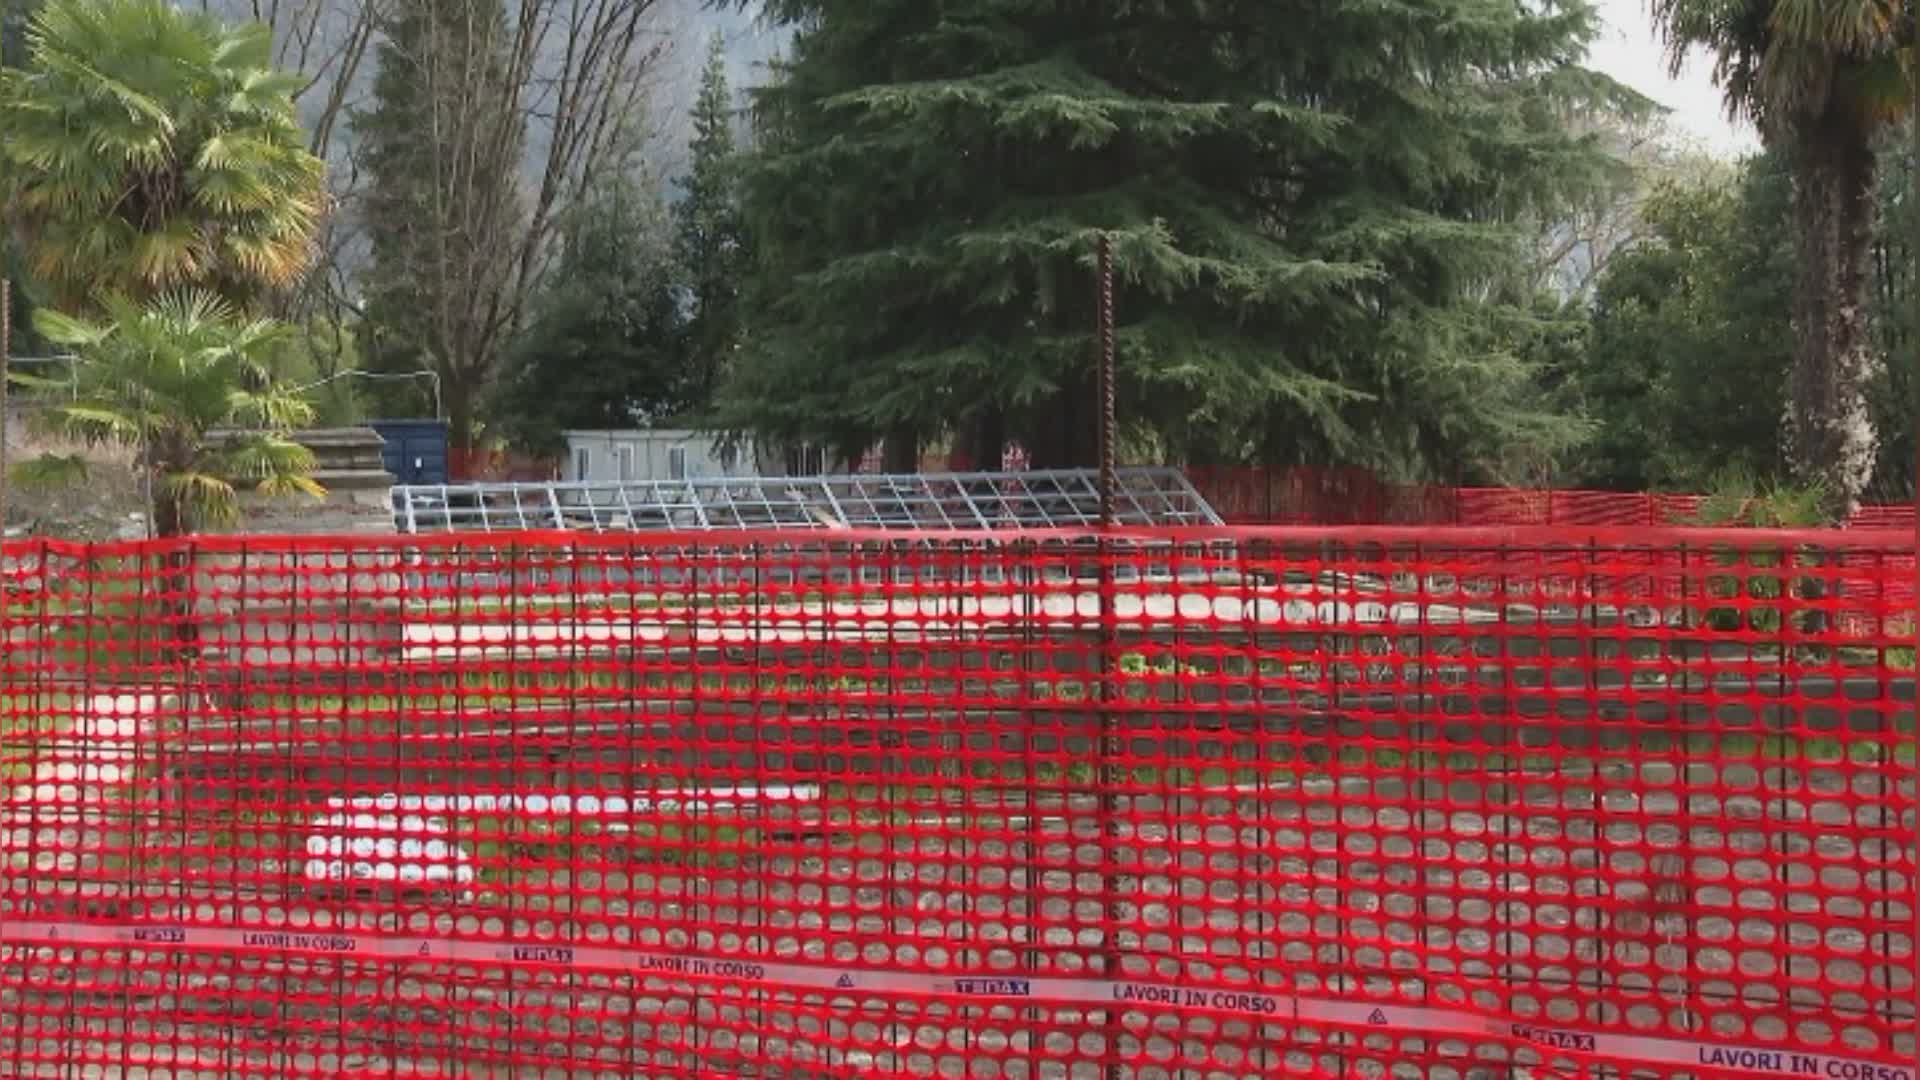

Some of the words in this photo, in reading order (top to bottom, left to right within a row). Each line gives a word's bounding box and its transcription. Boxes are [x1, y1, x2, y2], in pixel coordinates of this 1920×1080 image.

[693, 959, 710, 974] IN
[712, 962, 764, 979] CORSO
[1112, 984, 1179, 1004] LAVORI
[1185, 991, 1208, 1007] IN
[1212, 992, 1276, 1013] CORSO
[1699, 1048, 1782, 1070] LAVORI
[1790, 1055, 1818, 1075] IN
